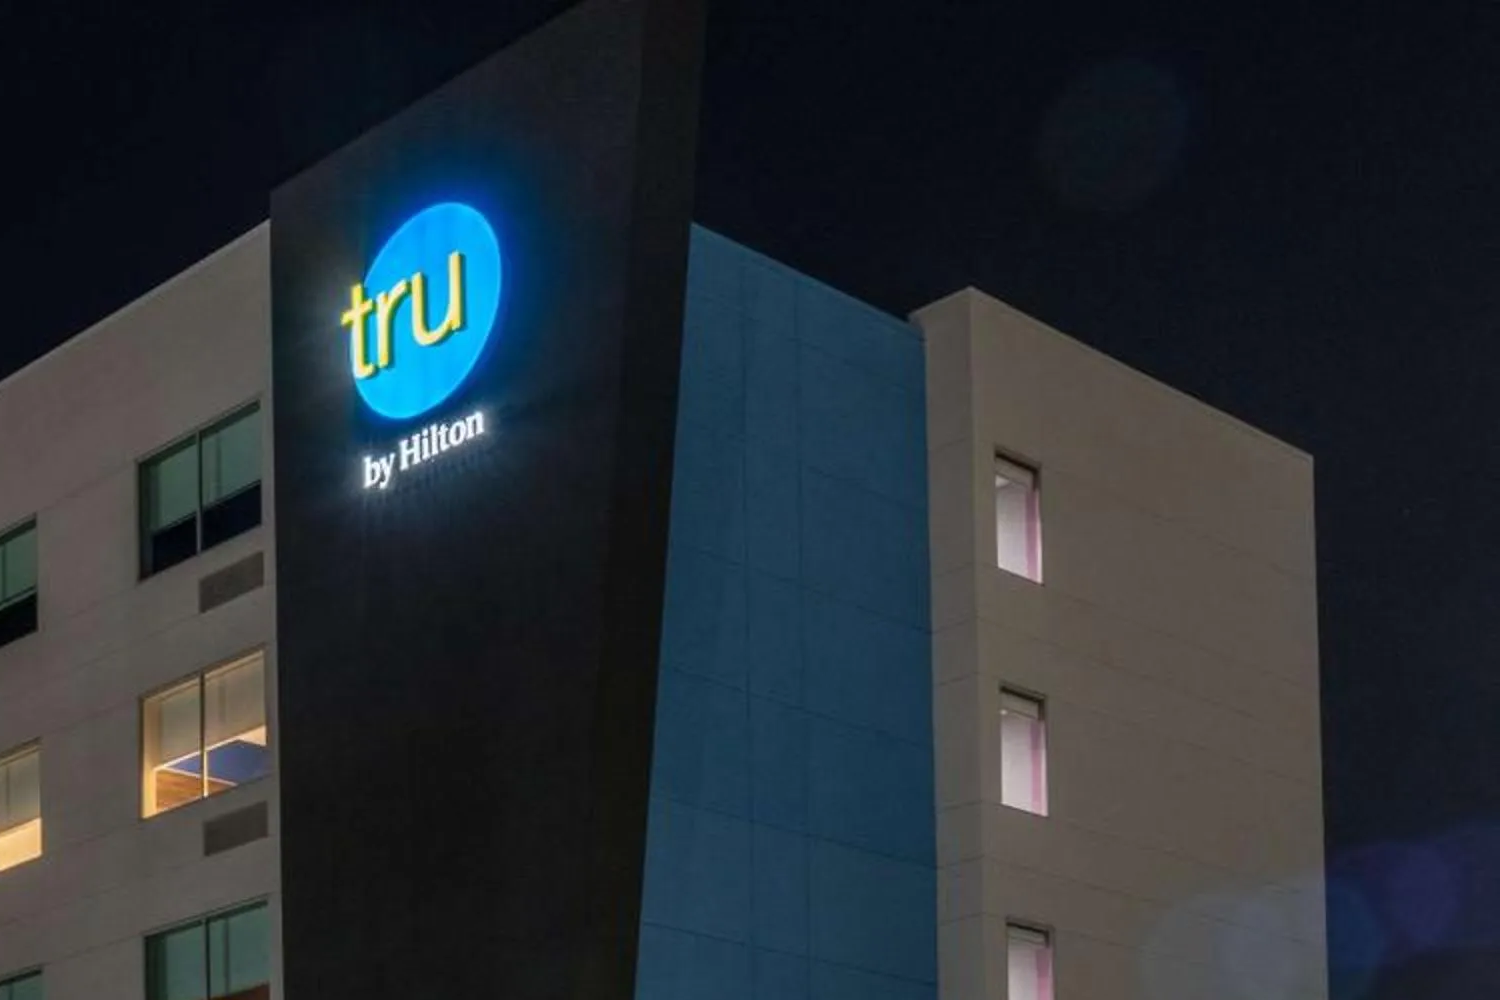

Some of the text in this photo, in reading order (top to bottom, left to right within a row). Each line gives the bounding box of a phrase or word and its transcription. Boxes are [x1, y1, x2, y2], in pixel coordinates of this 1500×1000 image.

[341, 251, 462, 379] tru
[364, 411, 484, 489] by Hilton
